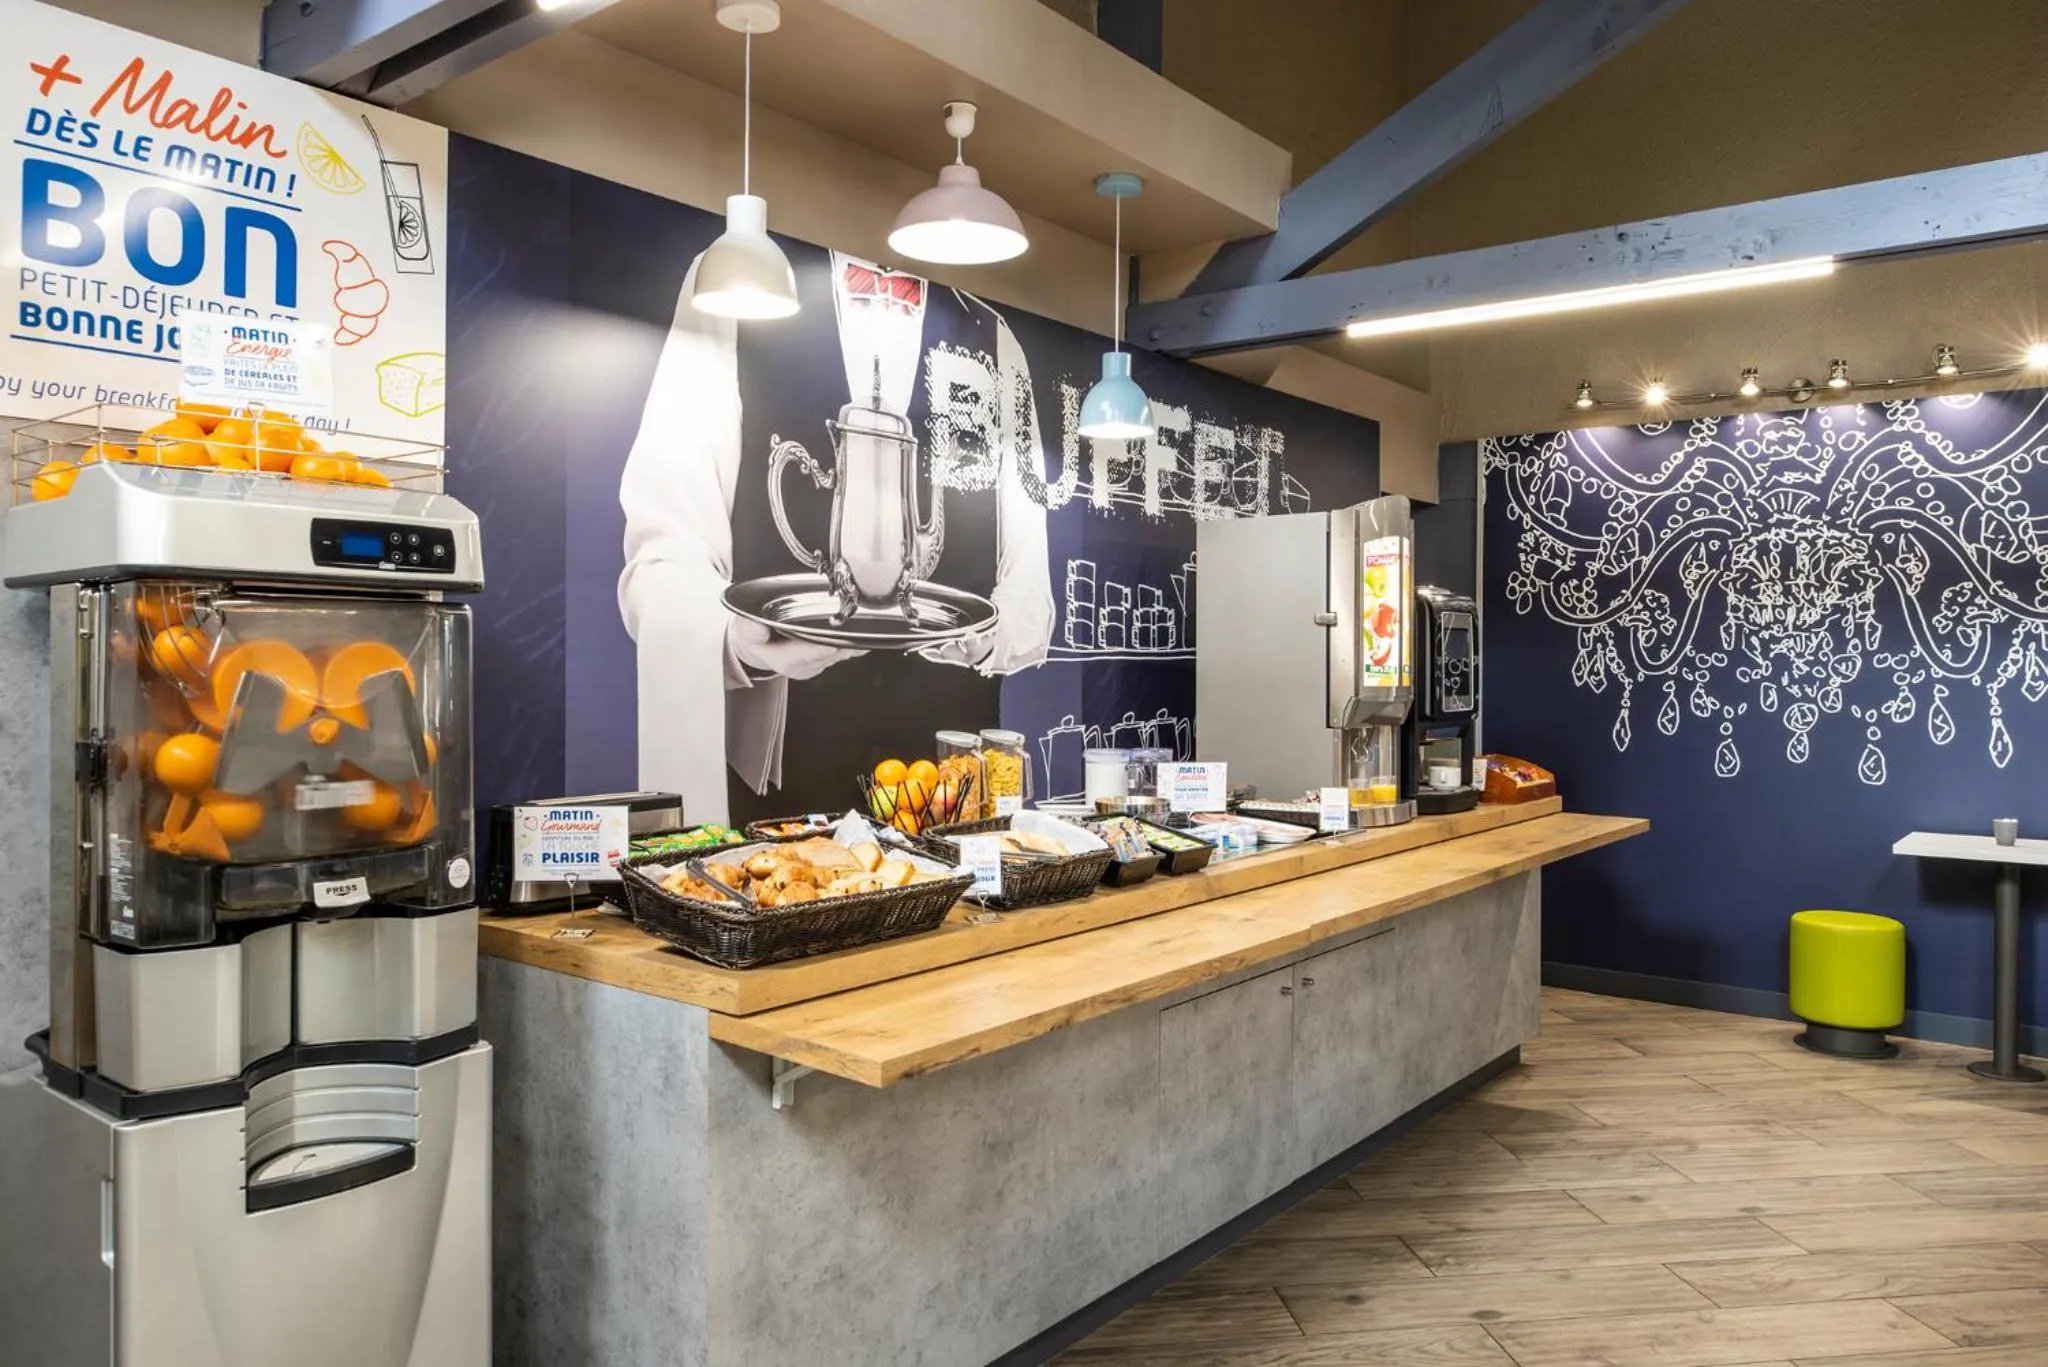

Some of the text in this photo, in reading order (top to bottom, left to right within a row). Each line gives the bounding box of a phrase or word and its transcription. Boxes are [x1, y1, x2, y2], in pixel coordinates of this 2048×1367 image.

[90, 57, 288, 159] Malin
[26, 107, 297, 198] DÈS LE MATIN !
[21, 157, 298, 308] BON
[19, 301, 143, 344] BONNE
[232, 326, 289, 344] MATIN
[32, 380, 87, 399] your
[304, 415, 339, 436] day
[549, 810, 593, 820] MATIN
[542, 852, 600, 863] PLAISIR
[326, 884, 357, 895] PRESS
